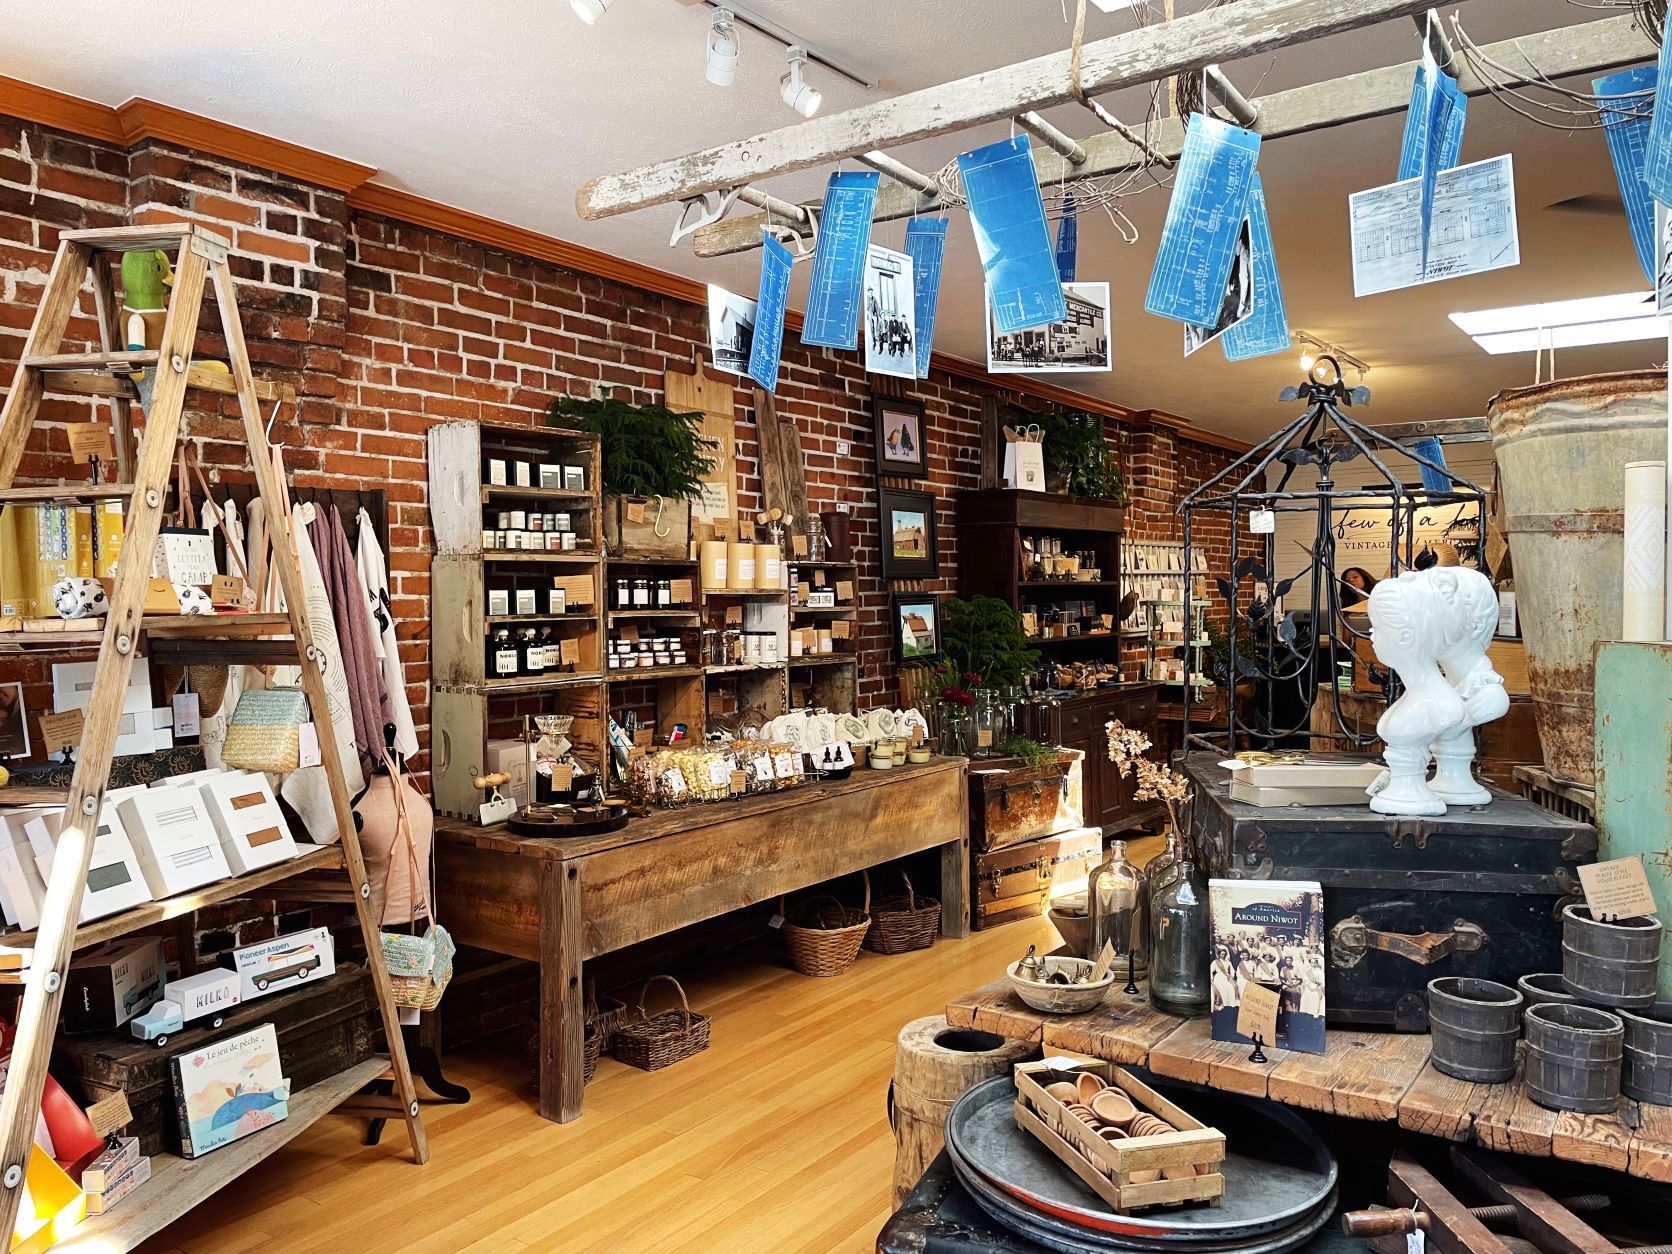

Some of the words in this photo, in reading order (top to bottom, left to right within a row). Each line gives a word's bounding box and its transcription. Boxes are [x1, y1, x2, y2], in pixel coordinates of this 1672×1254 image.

[1332, 509, 1380, 539] few
[1419, 515, 1438, 526] a
[1344, 541, 1392, 550] VINTAGE
[181, 572, 208, 584] CAMP
[1234, 912, 1269, 922] AROUND
[1271, 915, 1298, 924] NIWOT
[240, 949, 266, 960] Pioneer
[267, 943, 290, 953] Aspen
[207, 1051, 216, 1060] Le
[217, 1046, 229, 1056] jeu
[229, 1042, 238, 1052] de
